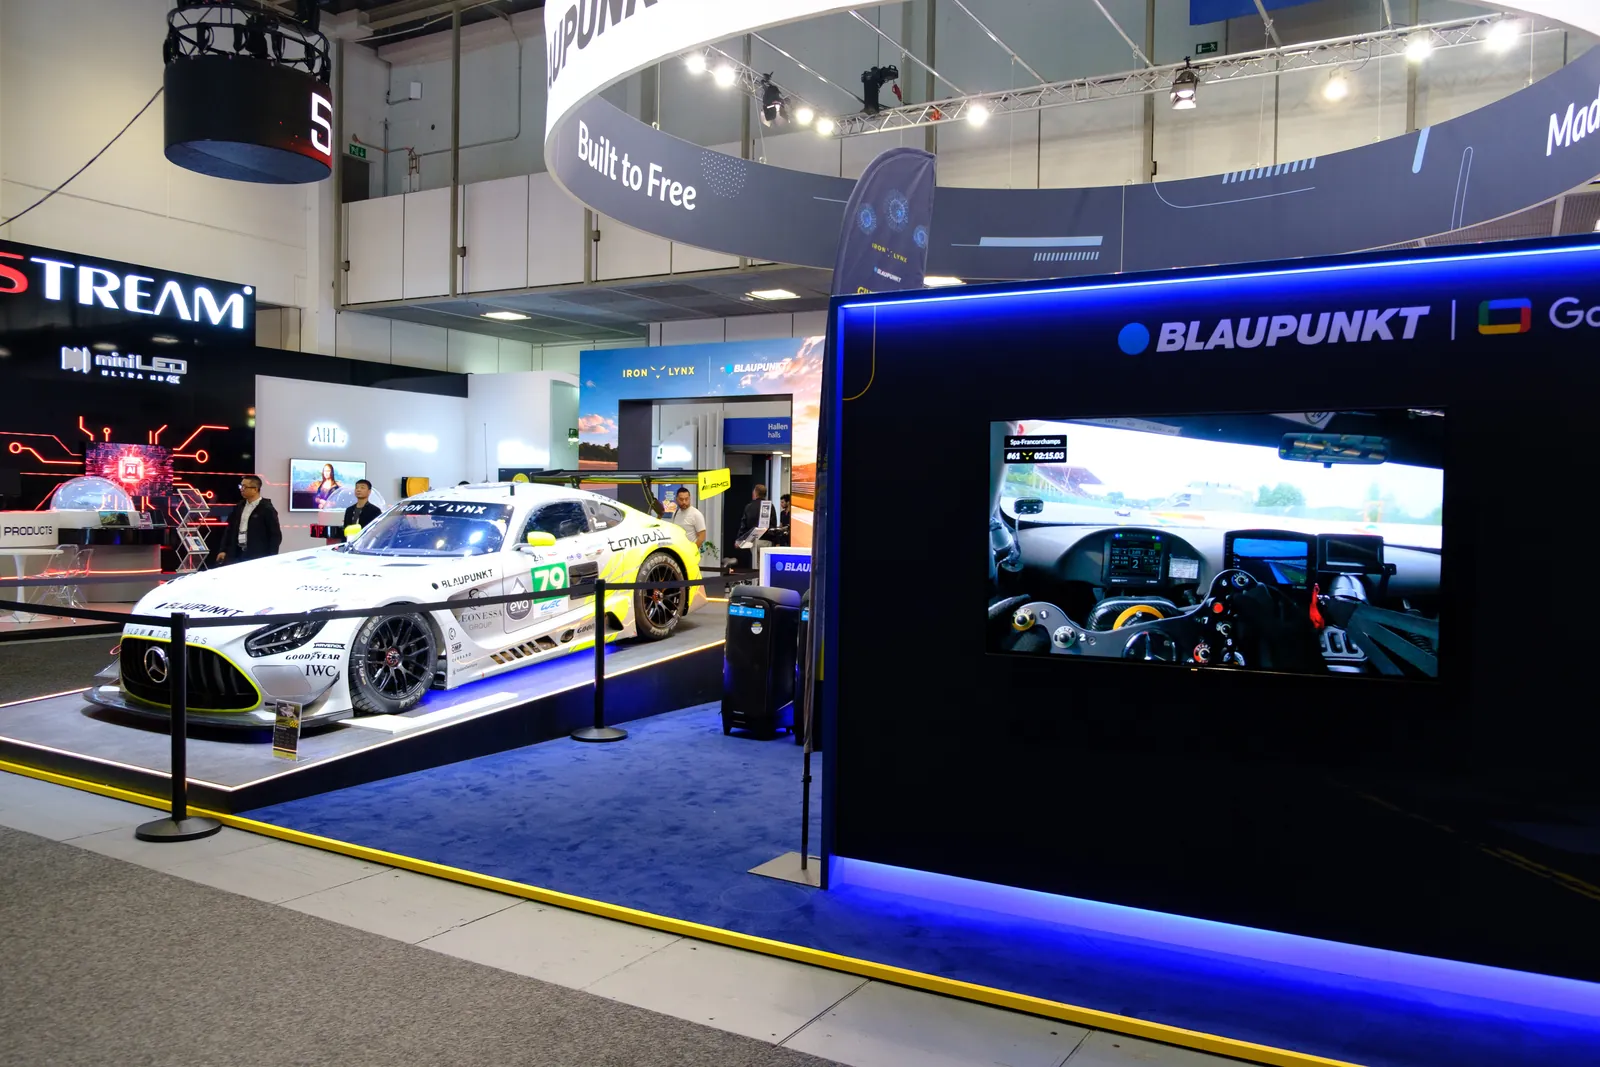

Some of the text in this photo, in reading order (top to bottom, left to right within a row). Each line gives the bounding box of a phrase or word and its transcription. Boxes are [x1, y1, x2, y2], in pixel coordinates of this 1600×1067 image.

[578, 119, 697, 211] Built to Free
[872, 242, 908, 264] IRON LYNX
[1155, 305, 1431, 353] BLAUPUNKT
[95, 351, 188, 375] miniLED
[733, 361, 790, 374] BLAUPUNKT
[101, 369, 144, 380] ULTRA
[622, 365, 695, 379] IRON LYNX
[768, 422, 789, 431] Hallen
[768, 431, 782, 439] halls
[1009, 438, 1062, 447] Spa-Francorchamps
[1006, 451, 1065, 460] #61 02:15.03
[710, 481, 729, 489] AMG
[446, 504, 487, 515] LYNX
[3, 525, 53, 537] PRODUCTS
[1131, 559, 1139, 569] 2
[441, 568, 493, 589] BLAUPUNKT
[534, 566, 565, 592] 79
[165, 601, 245, 617] BLAUPUNKT
[469, 621, 493, 632] GROUP
[285, 651, 341, 661] GOODYEAR
[305, 664, 336, 677] IWC
